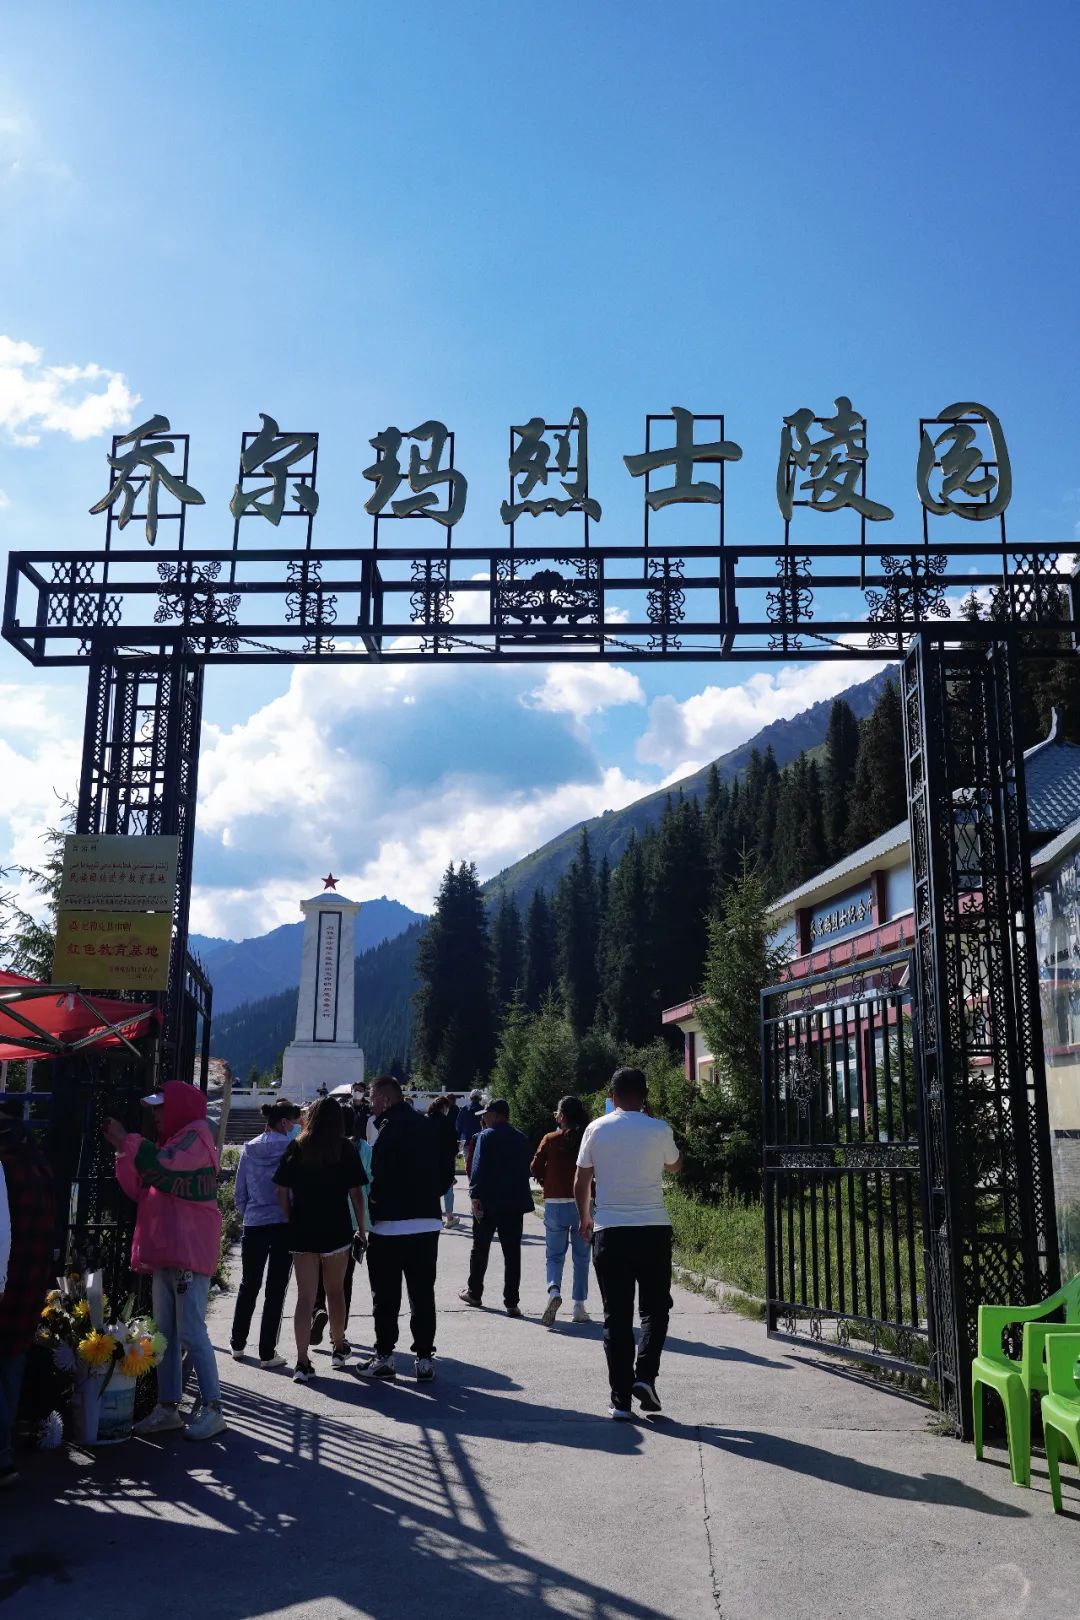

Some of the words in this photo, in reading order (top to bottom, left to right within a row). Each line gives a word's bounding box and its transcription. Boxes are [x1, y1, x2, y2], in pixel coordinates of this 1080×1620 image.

[89, 396, 1013, 547] 乔尔玛烈士陵园
[66, 943, 160, 958] 红色教育基地
